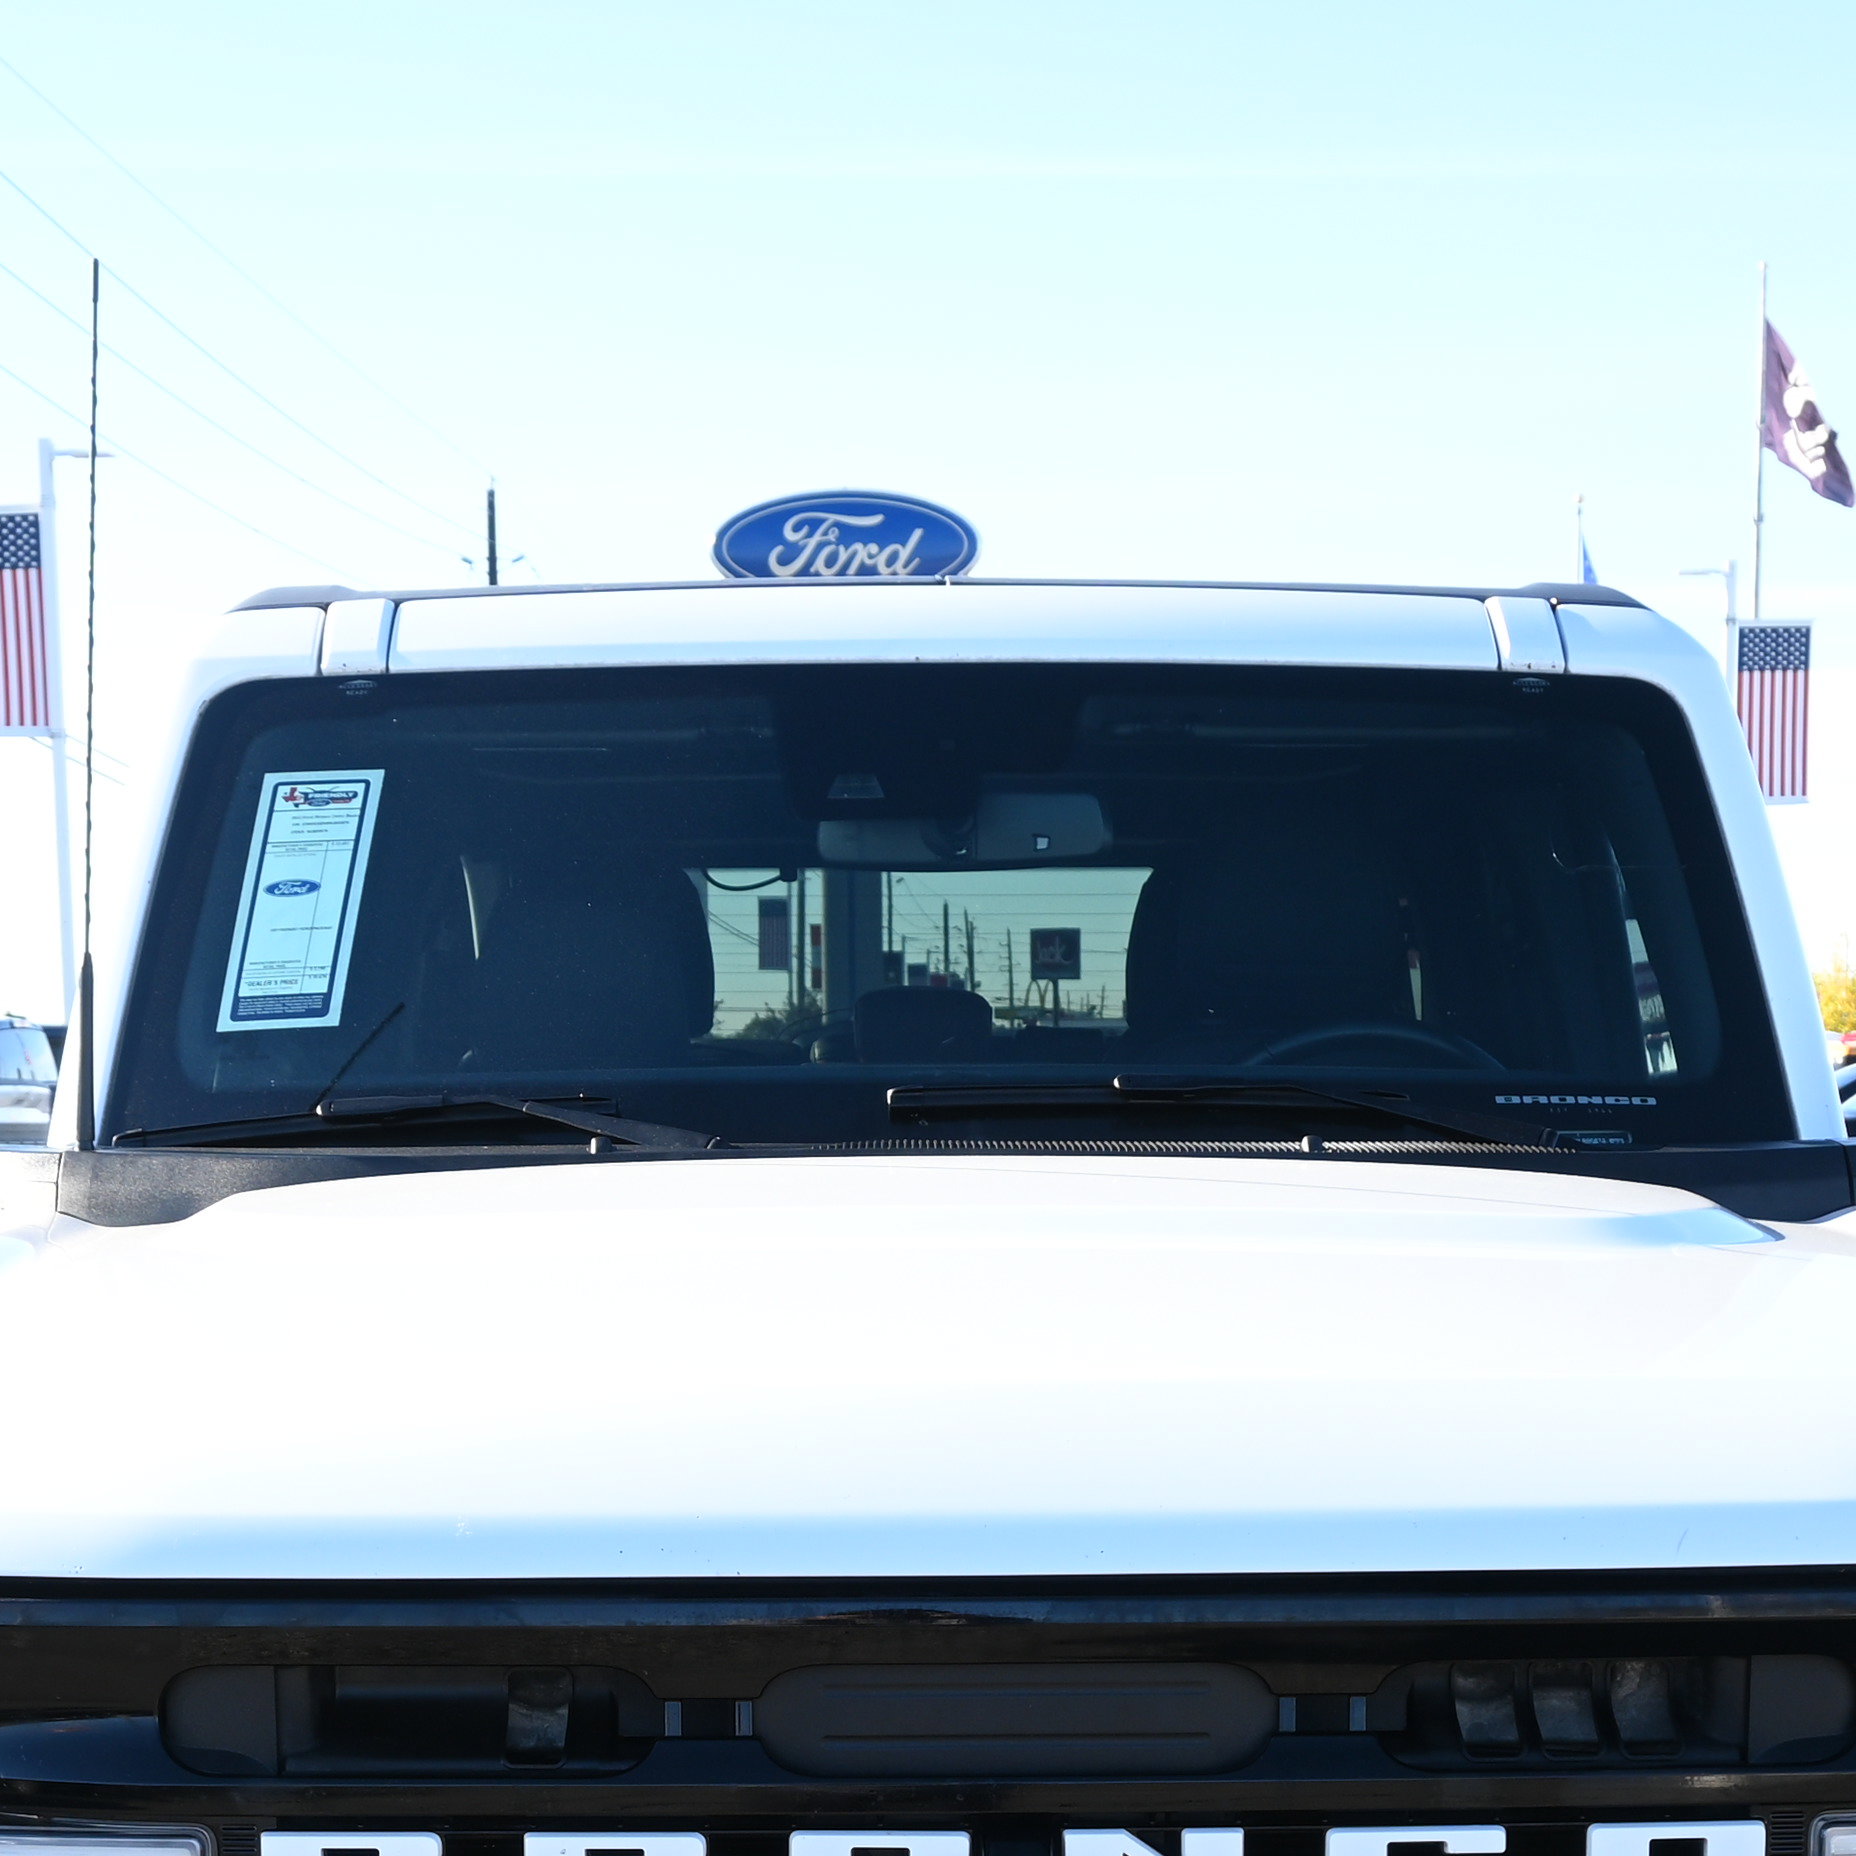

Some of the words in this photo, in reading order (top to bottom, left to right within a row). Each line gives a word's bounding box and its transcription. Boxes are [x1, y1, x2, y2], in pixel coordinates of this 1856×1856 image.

[768, 511, 924, 577] Ford
[274, 881, 310, 895] Ford
[1495, 1095, 1657, 1106] BRONCO
